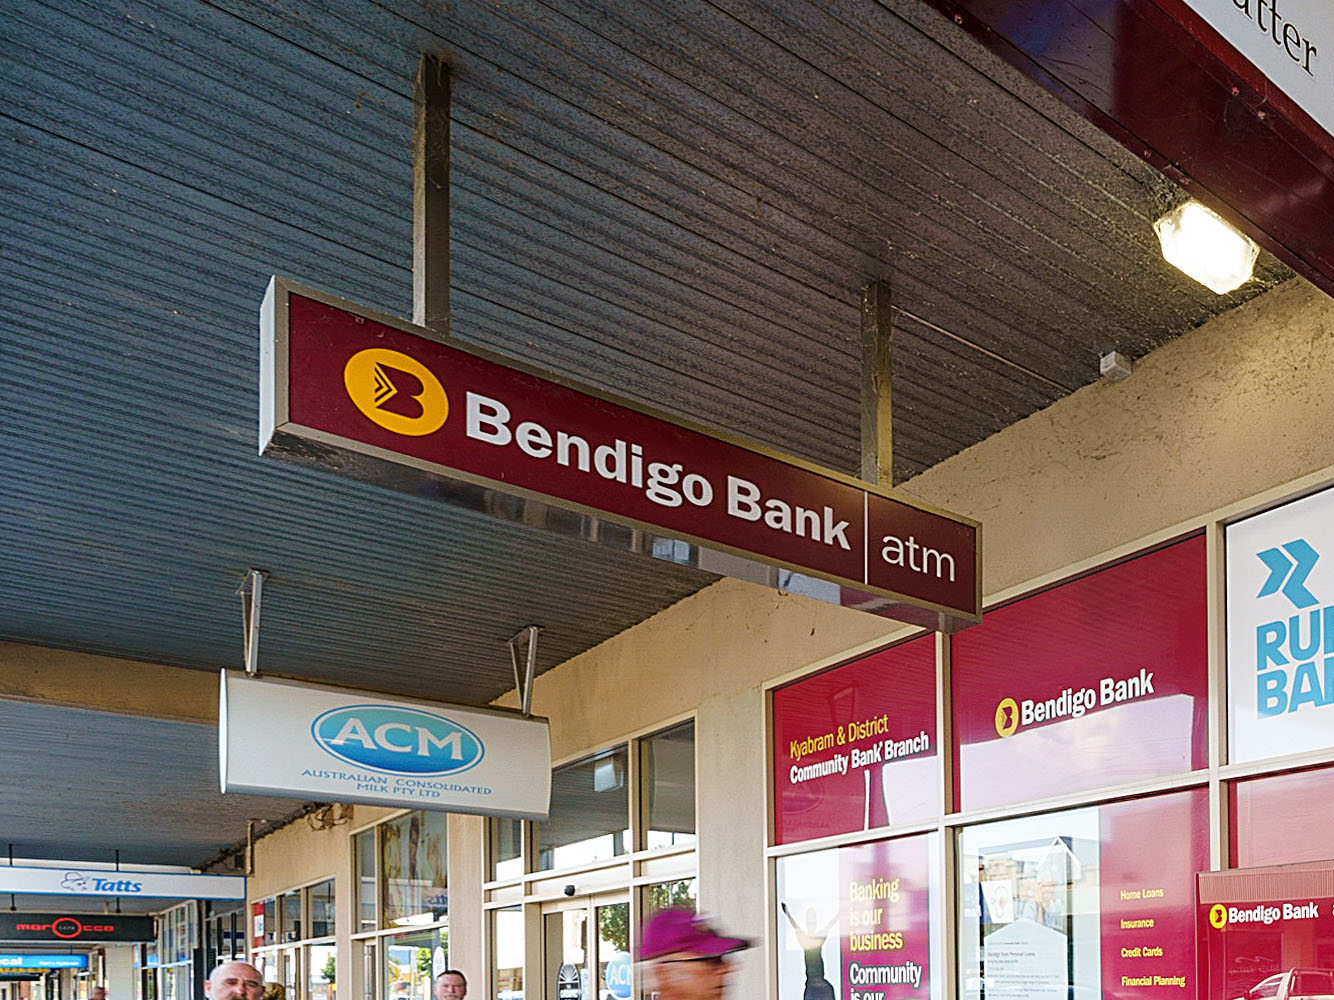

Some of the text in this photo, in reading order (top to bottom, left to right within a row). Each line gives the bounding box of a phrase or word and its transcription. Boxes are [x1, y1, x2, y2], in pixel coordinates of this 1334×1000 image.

[466, 391, 955, 582] Bendigo Bank atm
[1021, 668, 1154, 726] Bendigo Bank
[322, 717, 463, 761] ACM
[790, 714, 888, 761] Kyabram & District
[790, 754, 849, 784] Community
[884, 731, 930, 760] Branch
[302, 769, 492, 796] AUSTRALIAN CONSOLIDATED
[356, 783, 440, 798] MILK PTY LTD
[92, 877, 142, 893] Tatts
[850, 878, 899, 903] Banking
[1120, 888, 1164, 900] Home Loans
[850, 907, 883, 926] is our
[1120, 919, 1155, 929] Insurance
[1228, 905, 1281, 925] Bendigo
[1282, 901, 1319, 920] Bank
[850, 931, 903, 951] business
[1121, 946, 1163, 958] Credit Cards
[850, 961, 922, 988] Community
[1121, 975, 1186, 987] Financial Planning
